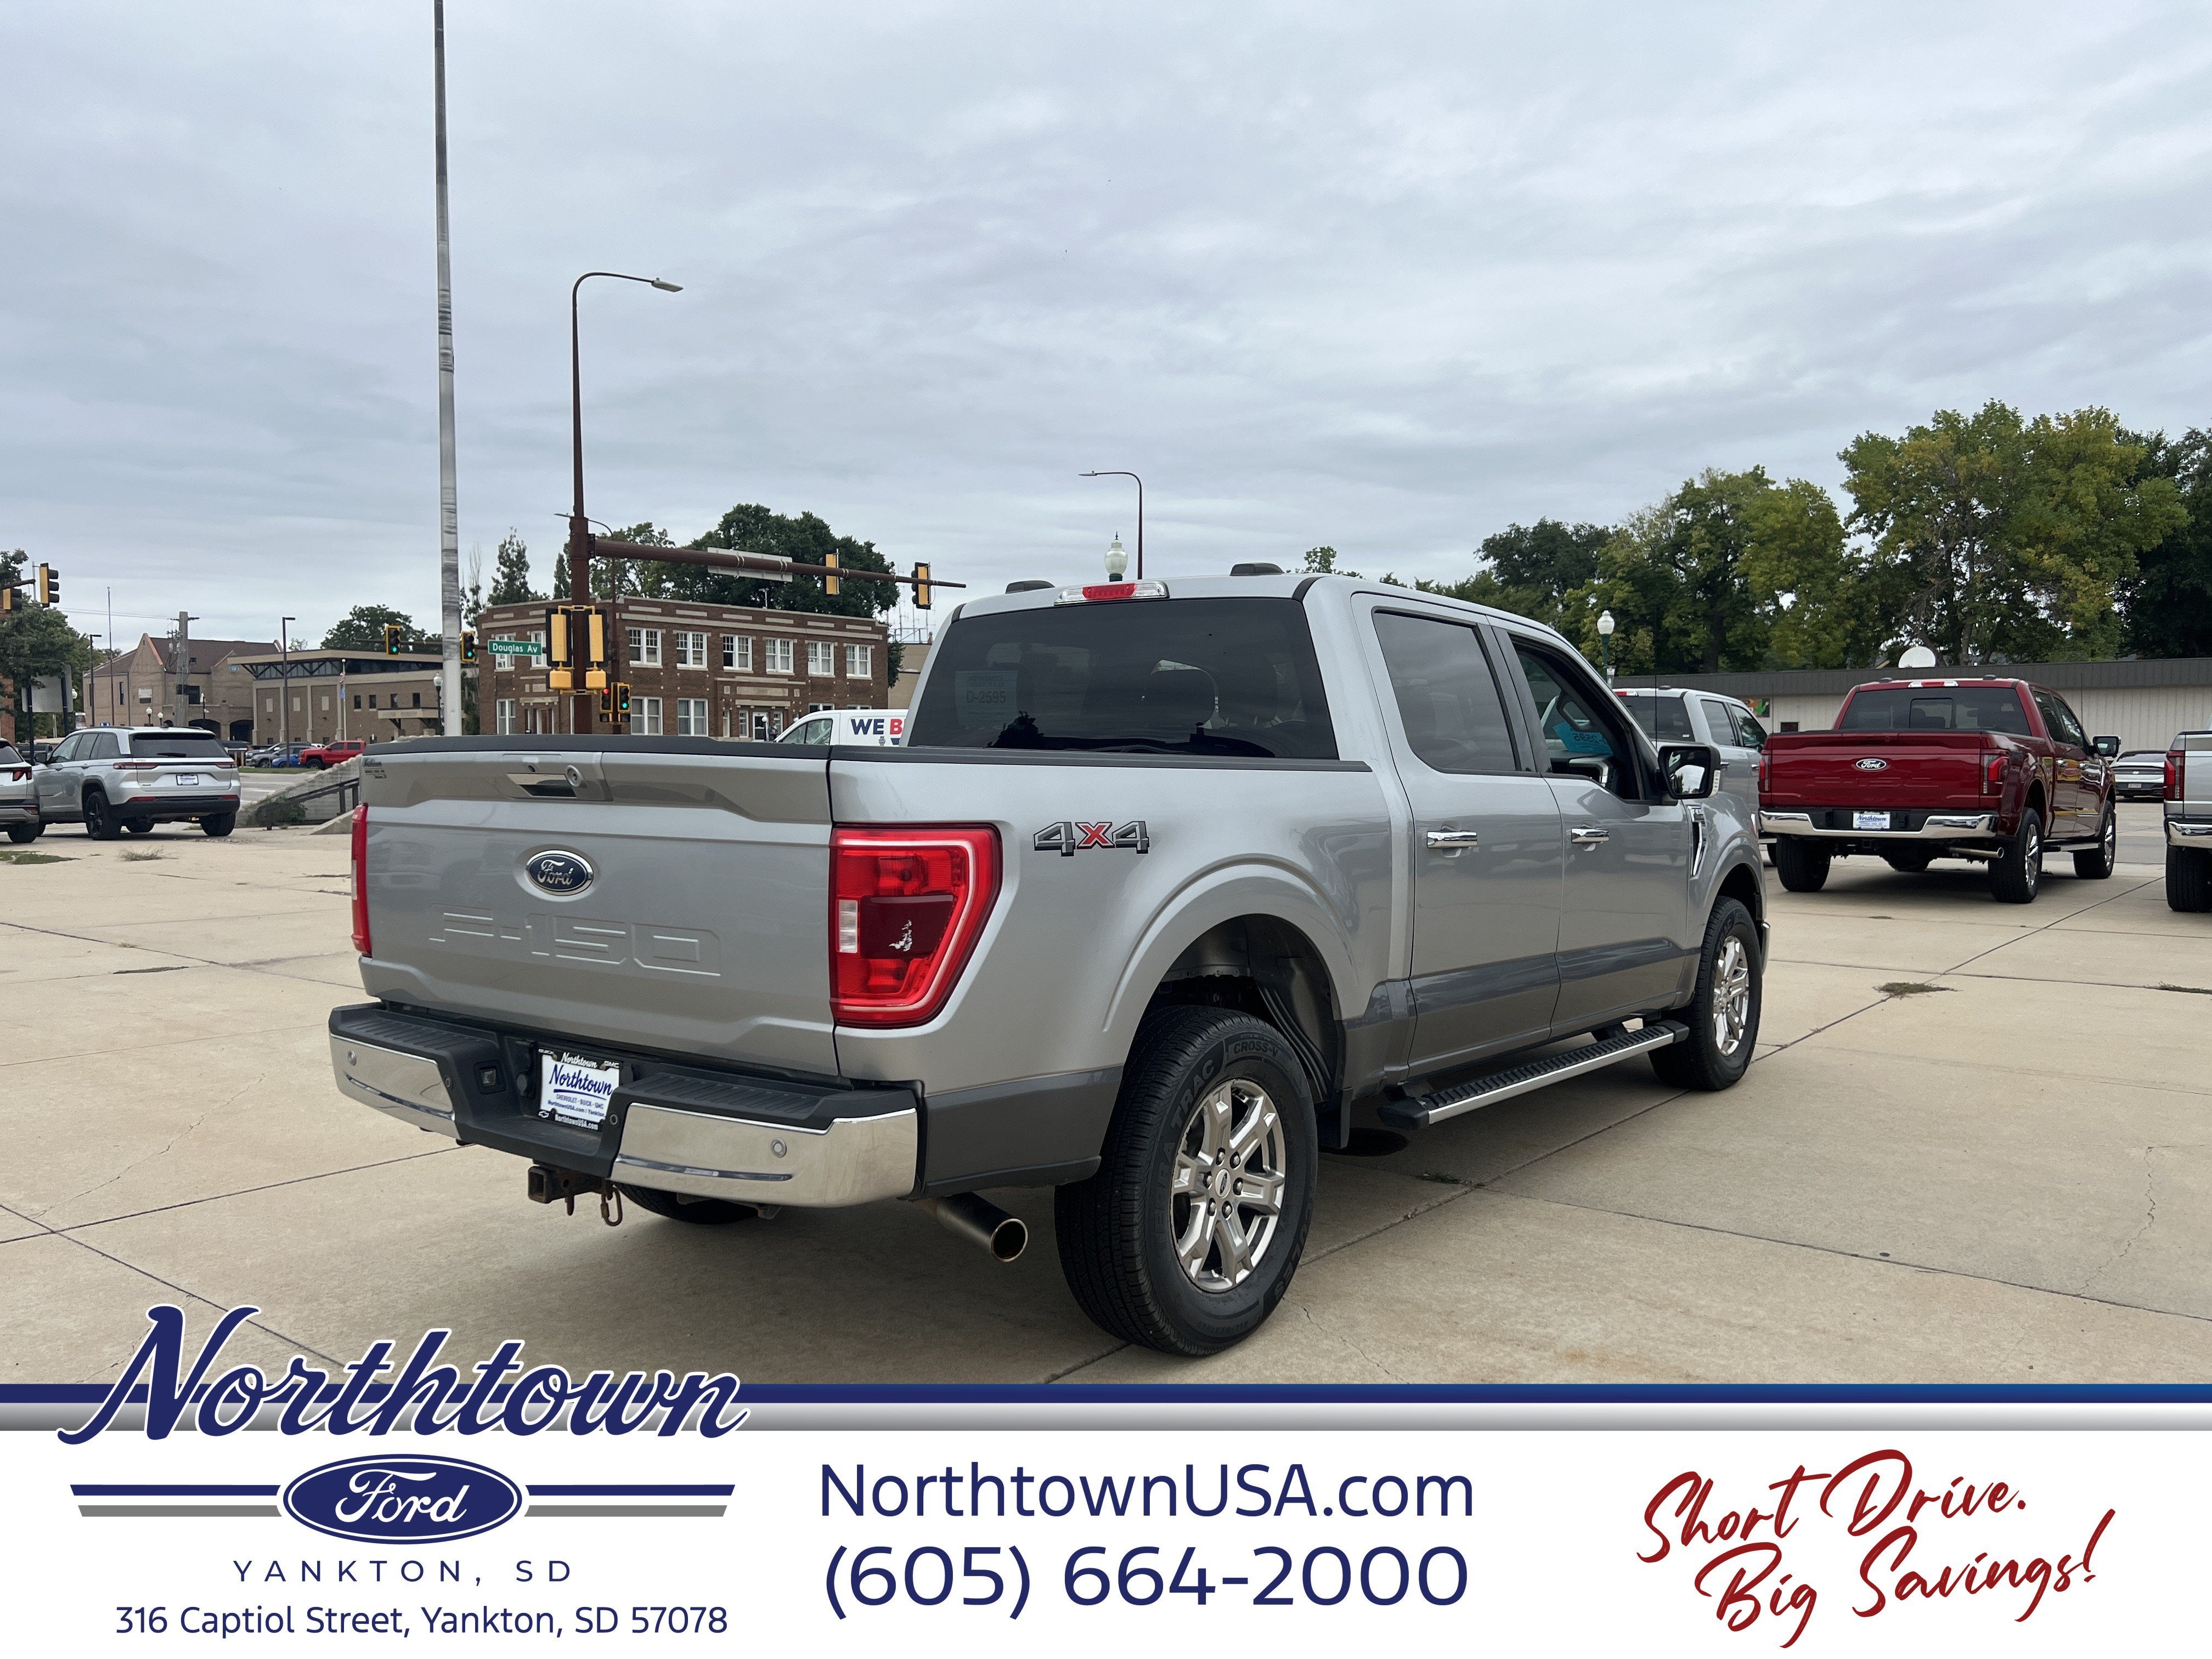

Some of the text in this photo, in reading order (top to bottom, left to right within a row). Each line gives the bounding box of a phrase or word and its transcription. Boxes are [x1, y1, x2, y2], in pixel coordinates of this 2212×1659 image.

[493, 643, 538, 654] Douglas Av
[966, 690, 1006, 703] D-2595
[850, 719, 884, 735] WE
[537, 859, 574, 885] Ford
[429, 903, 721, 976] F-150
[1233, 1041, 1279, 1057] CROSS-V
[561, 1052, 598, 1069] Northtown
[549, 1064, 613, 1096] Northtown
[1171, 1059, 1215, 1128] TRAC
[554, 1113, 599, 1130] NorthtownUSA.com
